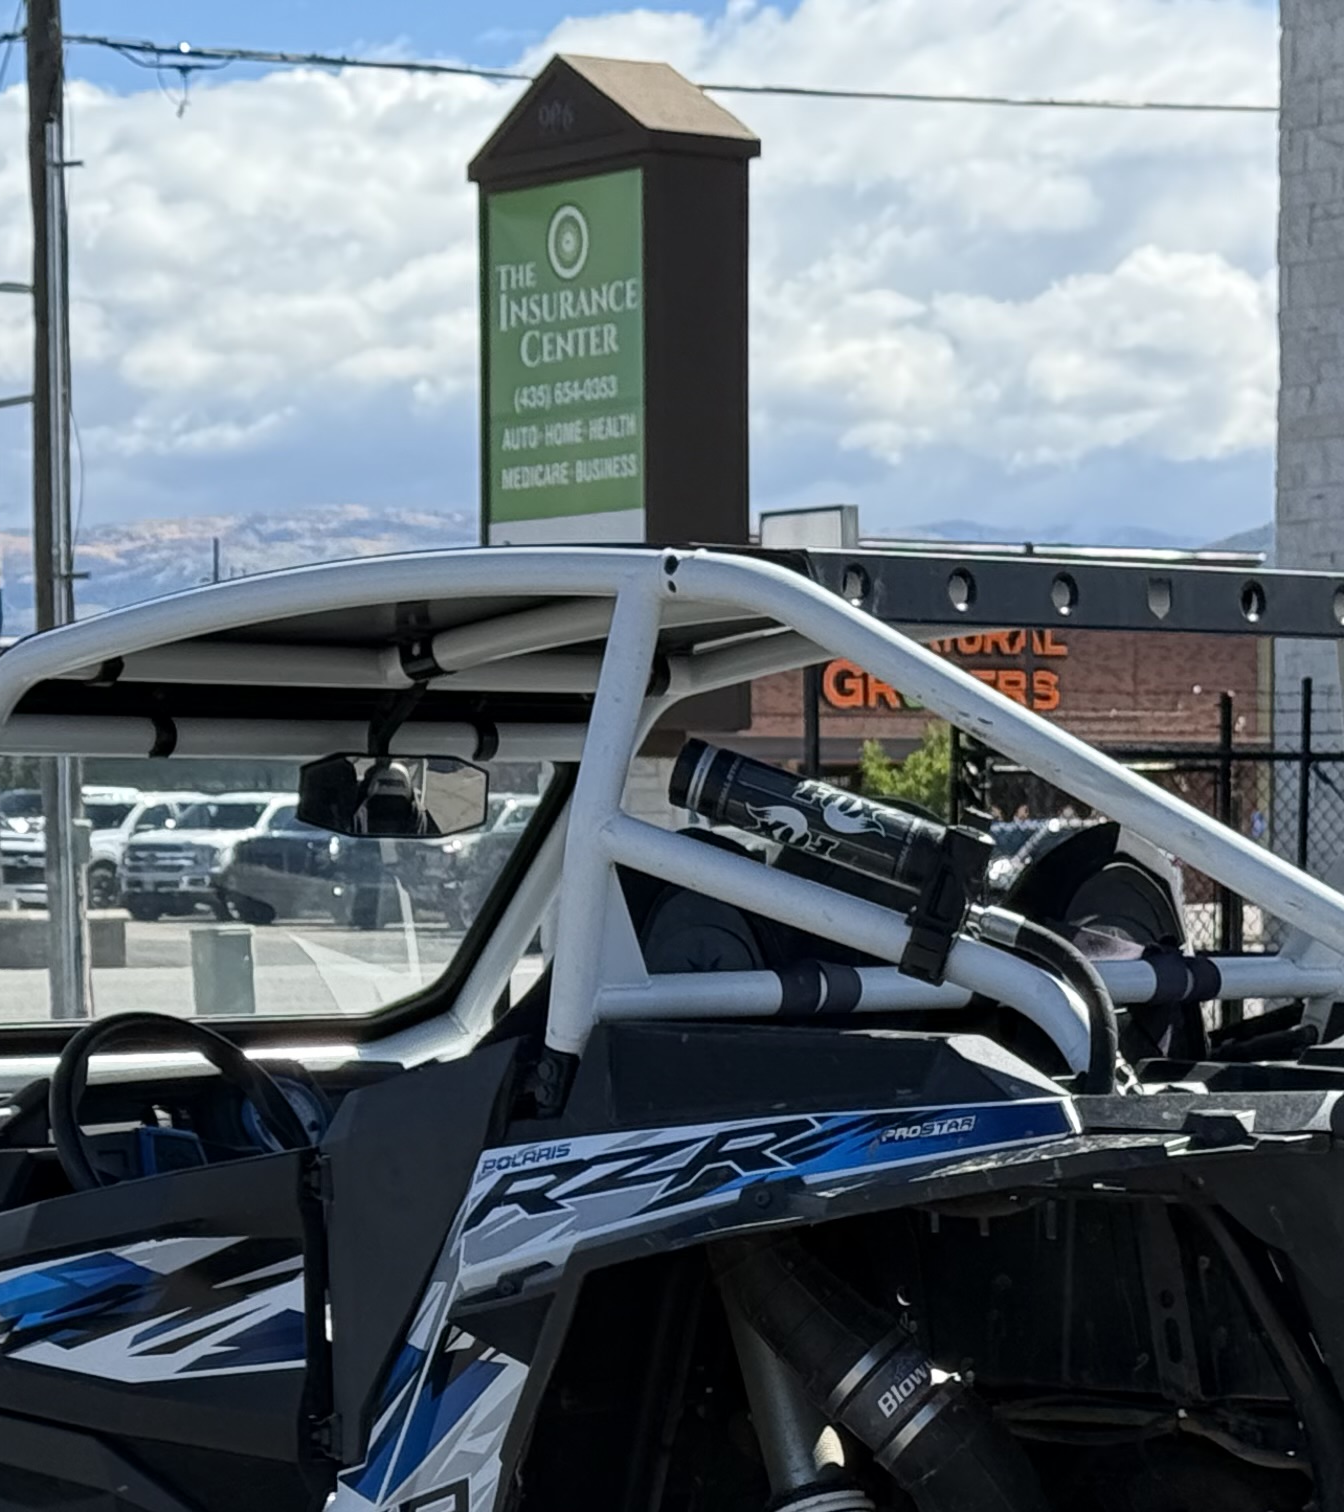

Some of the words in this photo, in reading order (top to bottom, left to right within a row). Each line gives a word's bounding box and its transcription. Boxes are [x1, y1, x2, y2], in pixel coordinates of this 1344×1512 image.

[495, 261, 537, 291] THE
[499, 277, 640, 332] INSURANCE
[520, 322, 620, 368] CENTER
[502, 425, 538, 451] AUTO
[544, 419, 583, 447] HOME
[589, 413, 636, 441] HEALTH
[501, 461, 570, 490] MEDICARE
[575, 453, 638, 484] BUSINESS
[880, 1115, 976, 1143] PROSTAR
[465, 1117, 821, 1229] RZR
[481, 1143, 572, 1174] POLARIS
